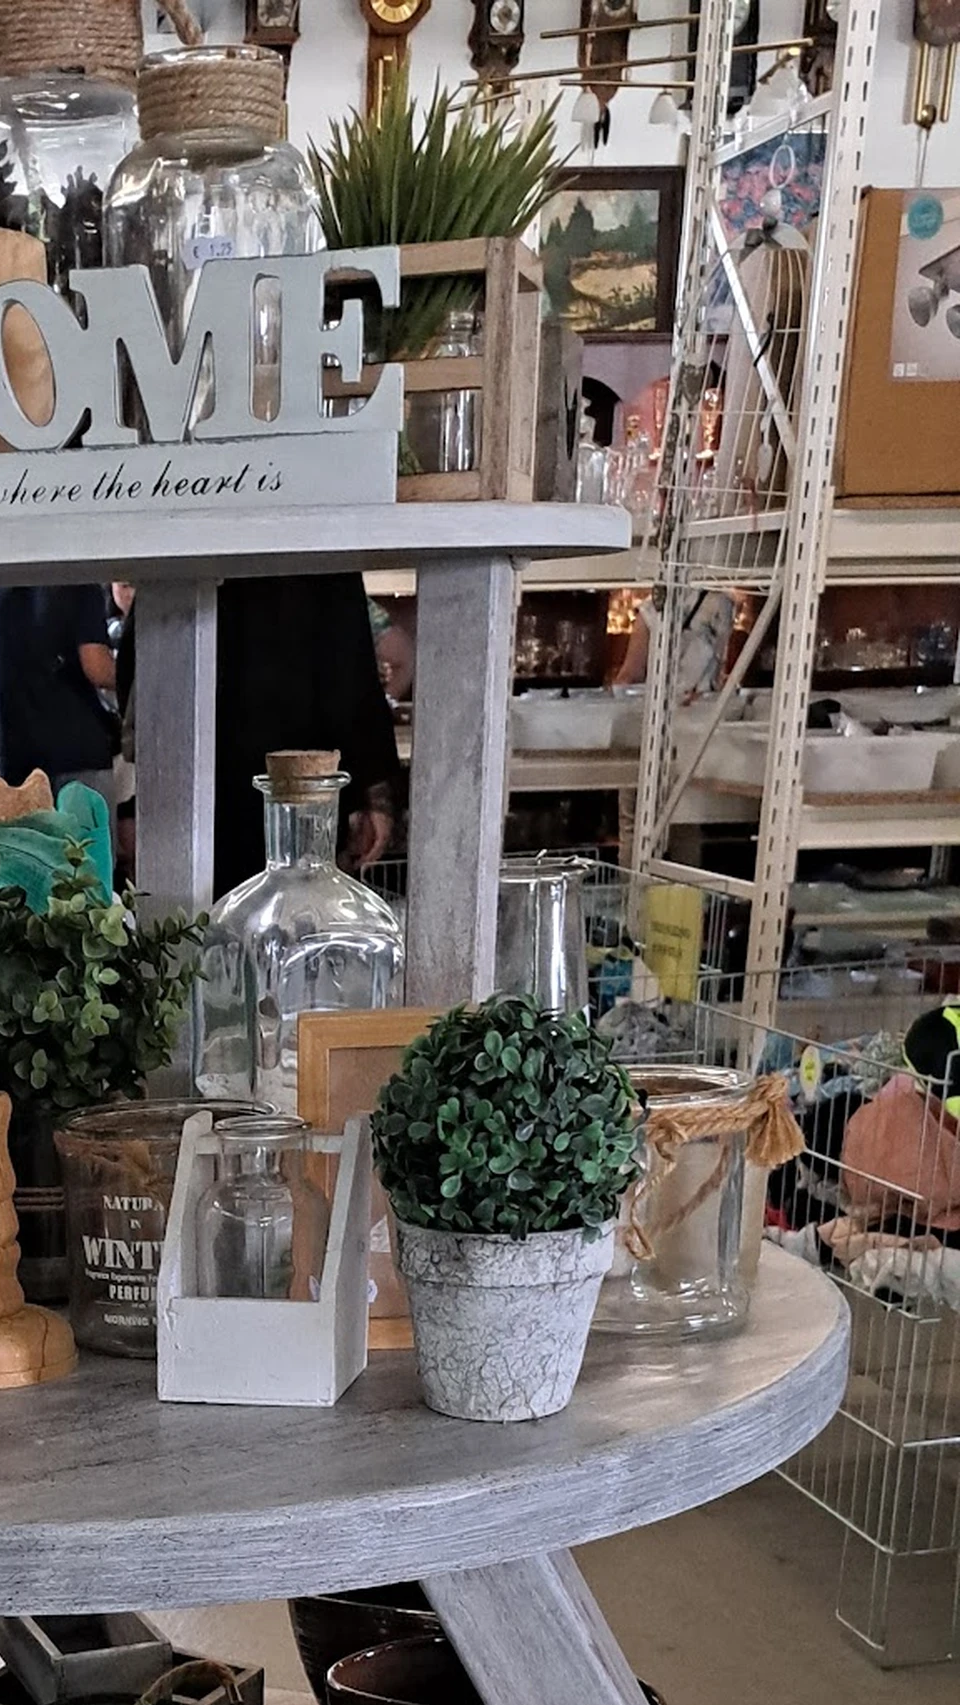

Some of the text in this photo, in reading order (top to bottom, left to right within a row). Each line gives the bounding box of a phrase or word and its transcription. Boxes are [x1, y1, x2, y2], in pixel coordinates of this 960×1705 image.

[92, 462, 143, 502] the
[152, 460, 251, 499] heart
[255, 461, 283, 493] is
